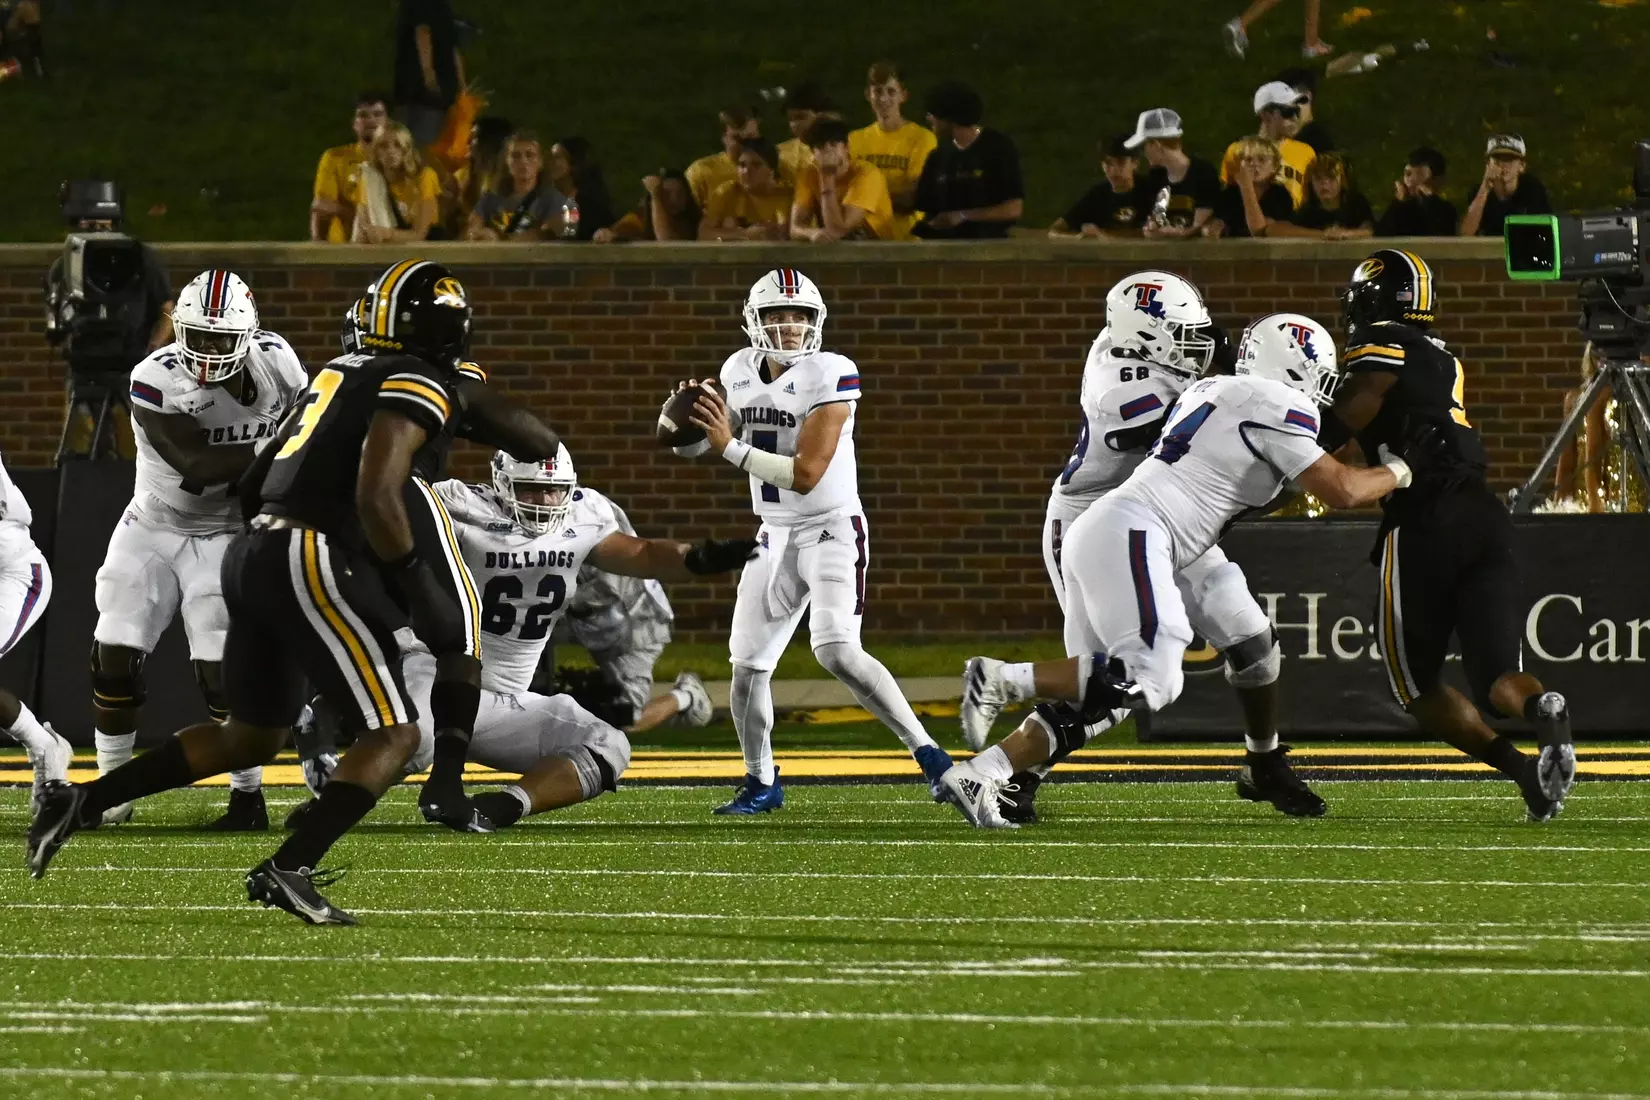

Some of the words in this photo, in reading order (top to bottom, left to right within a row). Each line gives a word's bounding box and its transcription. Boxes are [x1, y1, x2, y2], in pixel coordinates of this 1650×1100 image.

[1119, 366, 1149, 382] 68
[274, 368, 344, 460] 3
[485, 550, 575, 569] BULLDOGS
[480, 573, 567, 640] 62
